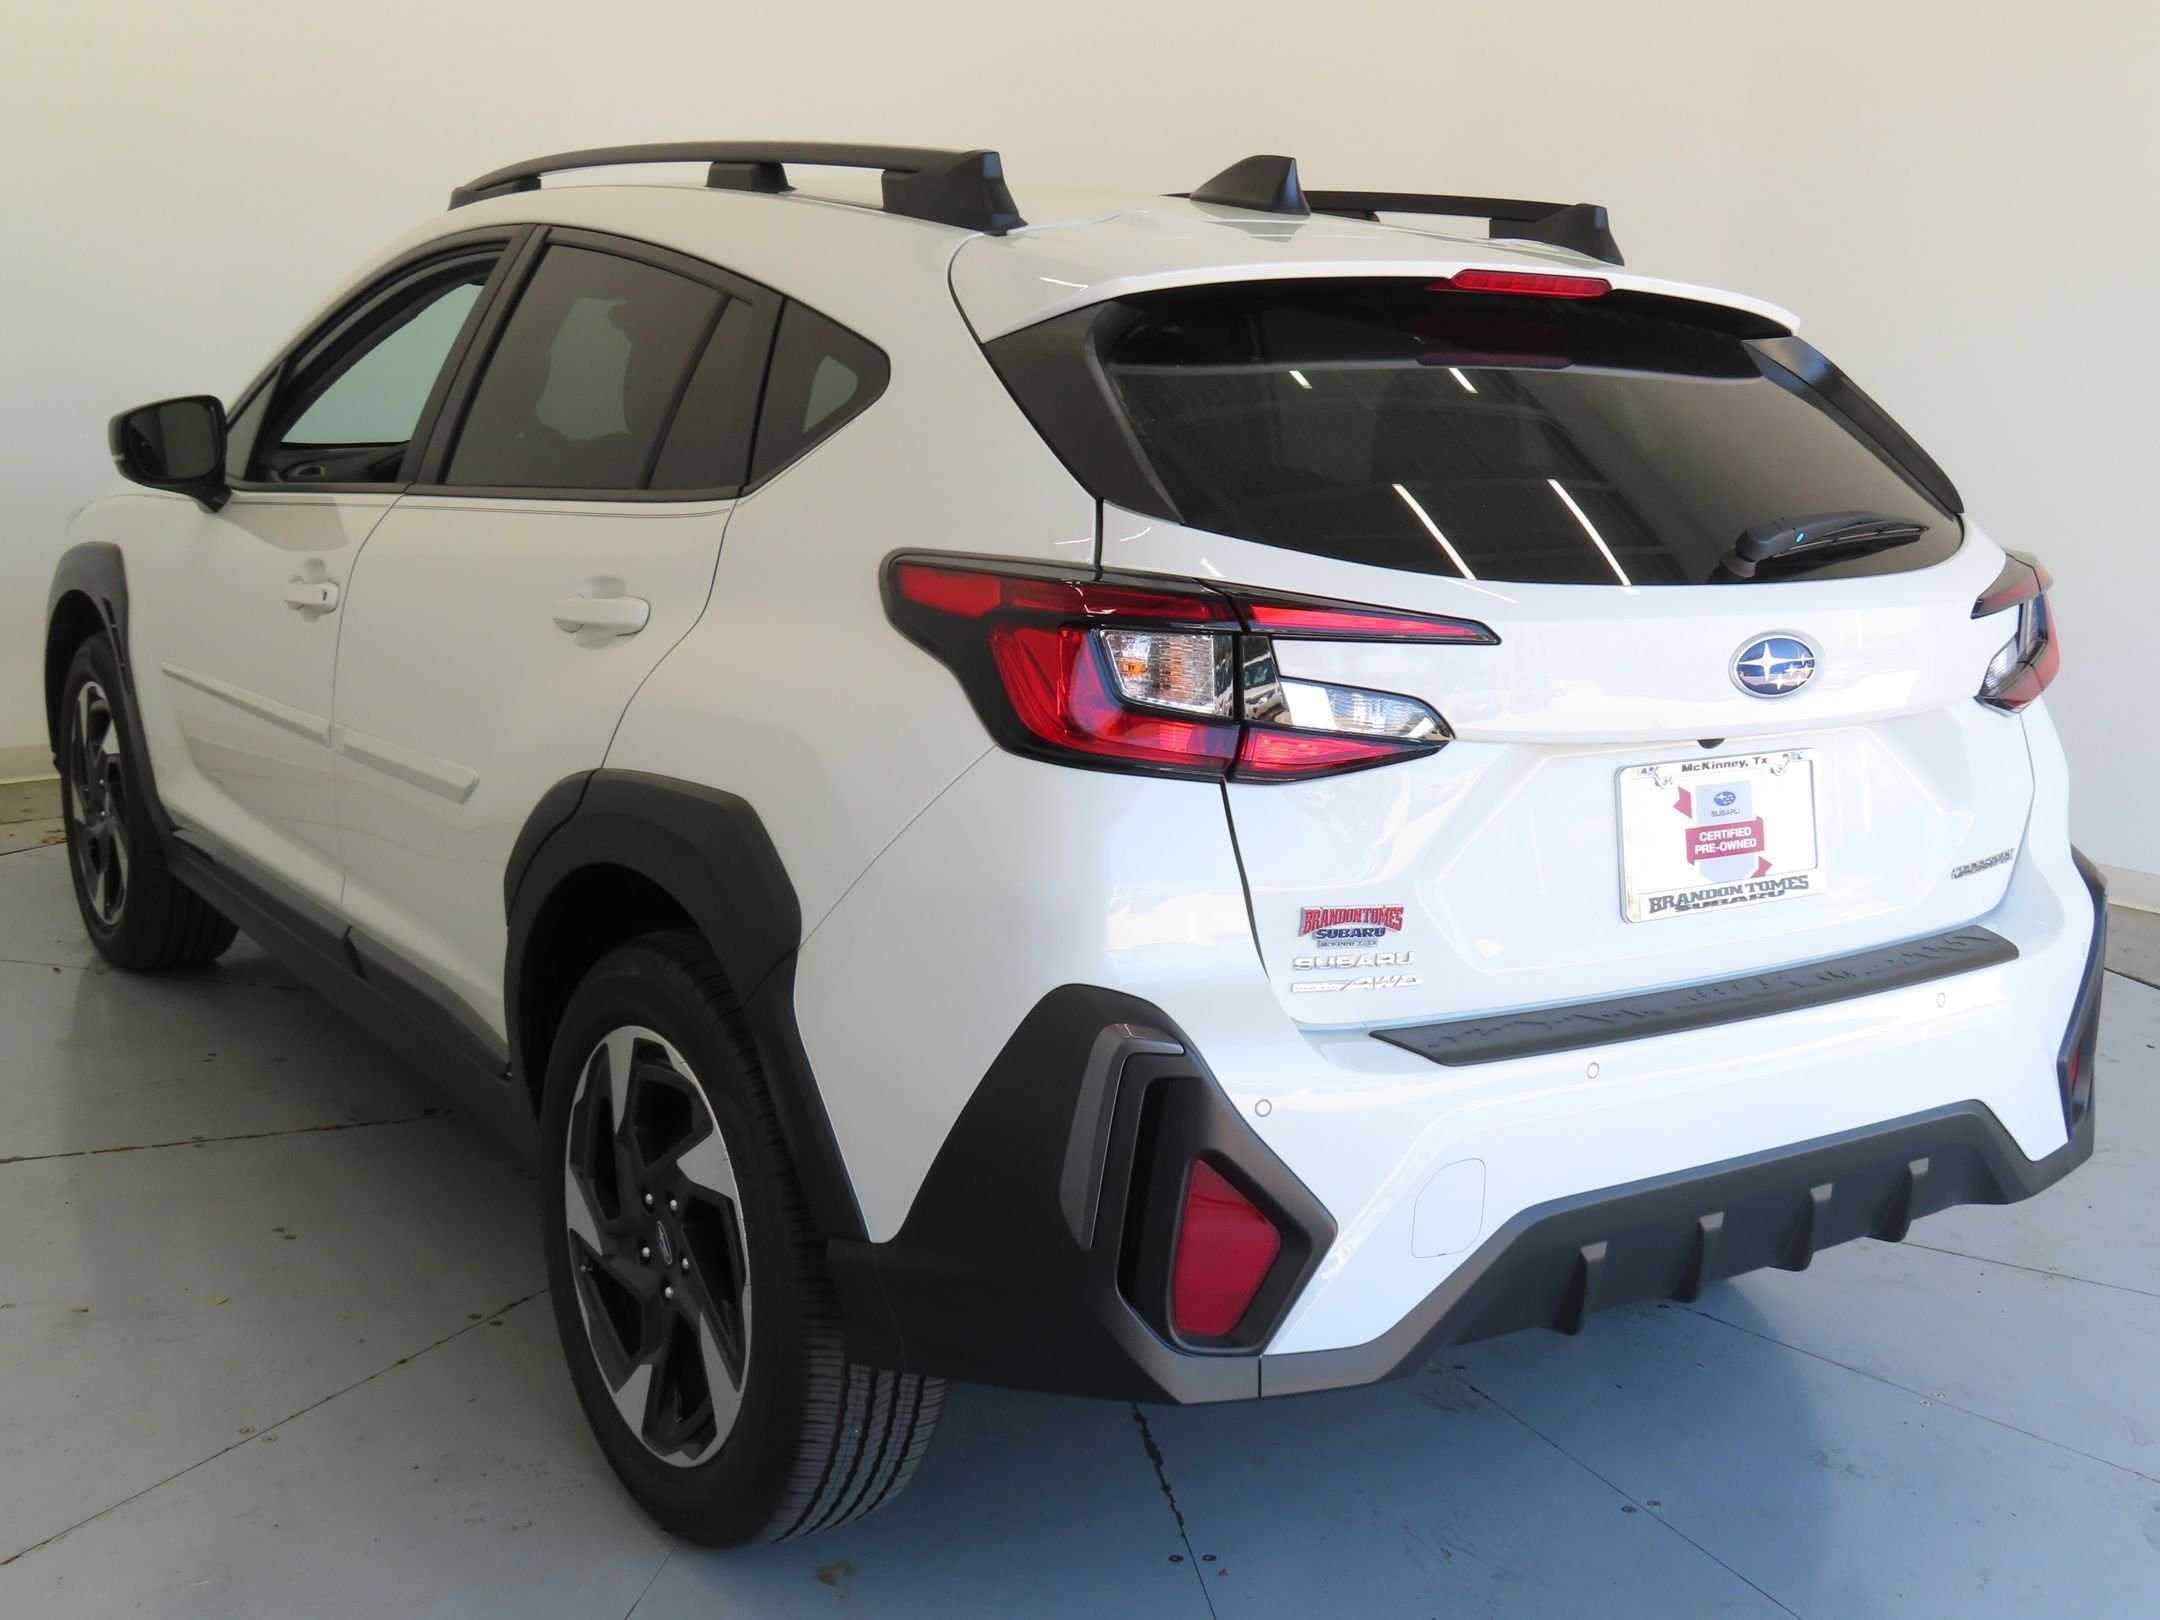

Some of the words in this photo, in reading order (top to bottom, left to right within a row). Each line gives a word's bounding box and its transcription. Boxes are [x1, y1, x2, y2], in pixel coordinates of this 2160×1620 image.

[1681, 759, 1749, 773] McKinney,
[1710, 809, 1740, 817] SUBARU
[1699, 827, 1751, 841] CERTIFIED
[1694, 838, 1757, 854] PRE-OWNED
[1648, 885, 1744, 913] BRANDON
[1745, 875, 1809, 893] TOMES
[1674, 889, 1785, 912] SUBARU
[1303, 908, 1361, 935] BRANDON
[1363, 906, 1404, 931] TOMES
[1315, 927, 1386, 940] SUBARU
[1293, 950, 1415, 970] SUBARU
[1341, 974, 1422, 991] AWD
